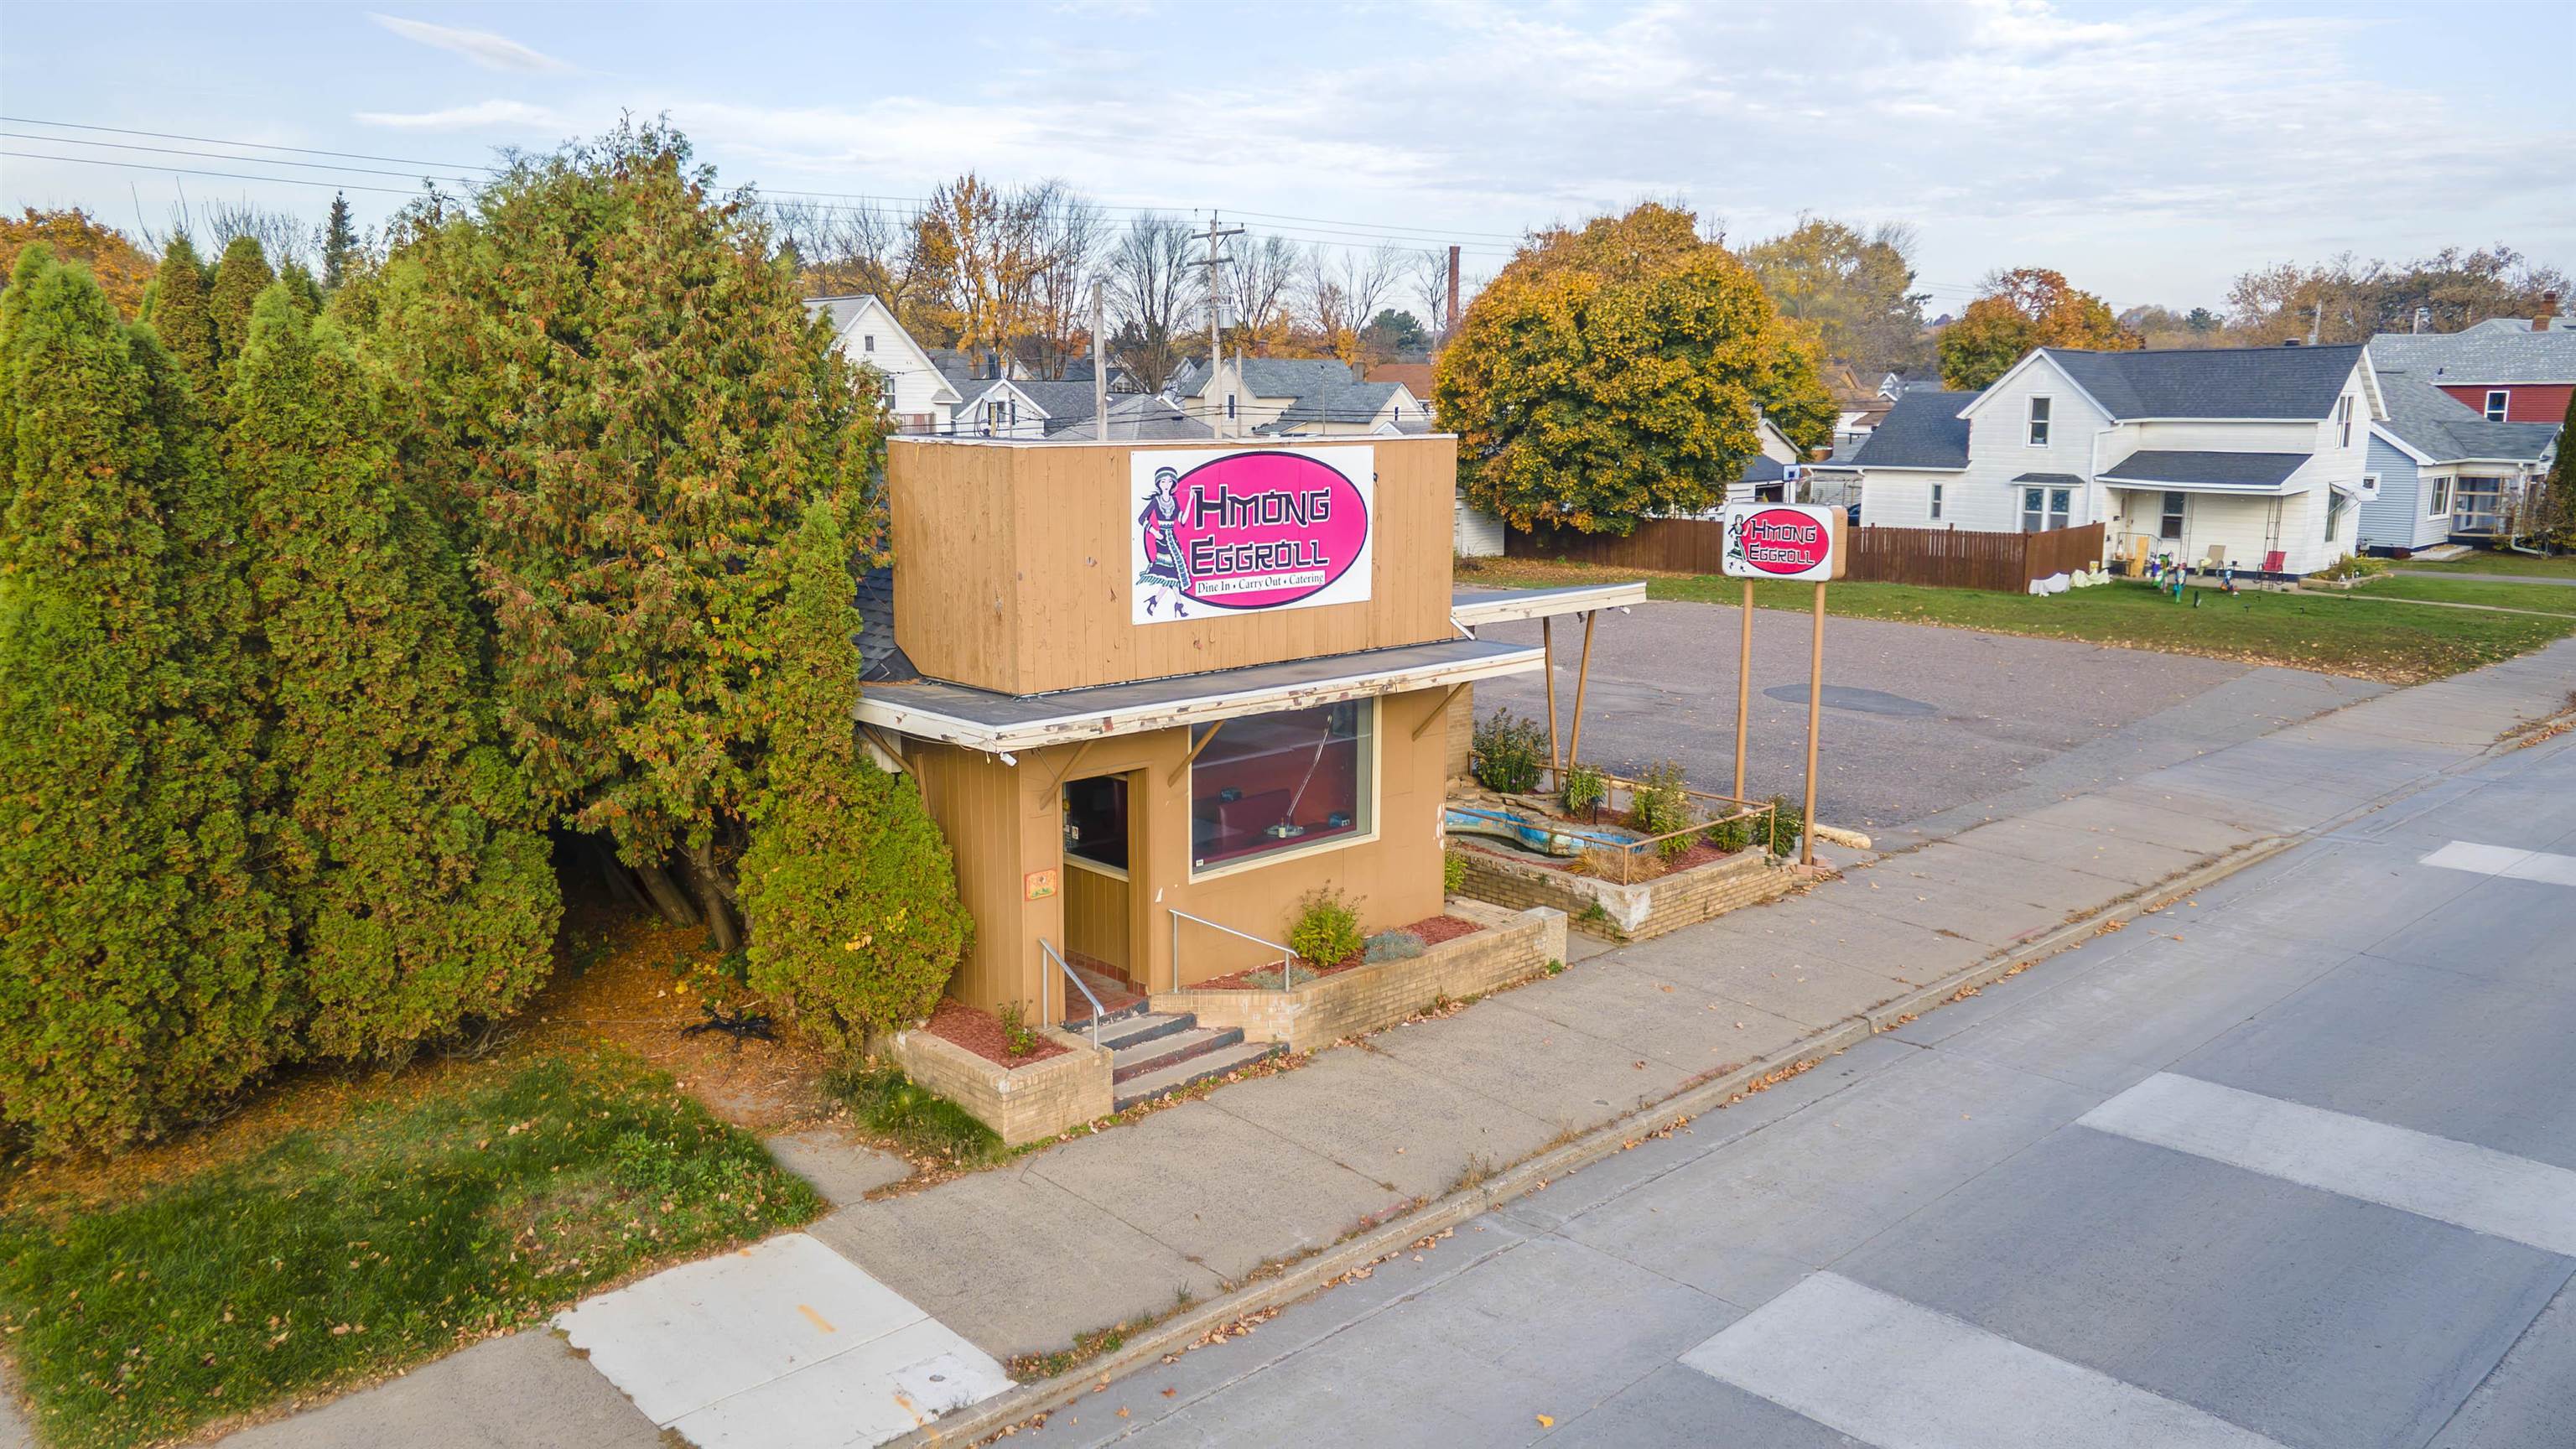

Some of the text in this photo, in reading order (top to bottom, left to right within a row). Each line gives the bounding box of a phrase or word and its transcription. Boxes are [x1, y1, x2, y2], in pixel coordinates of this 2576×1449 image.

[1191, 536, 1330, 575] EGGROLL
[1748, 543, 1815, 564] EGGROLL
[1197, 574, 1324, 594] Dine In Carry Out Catering
